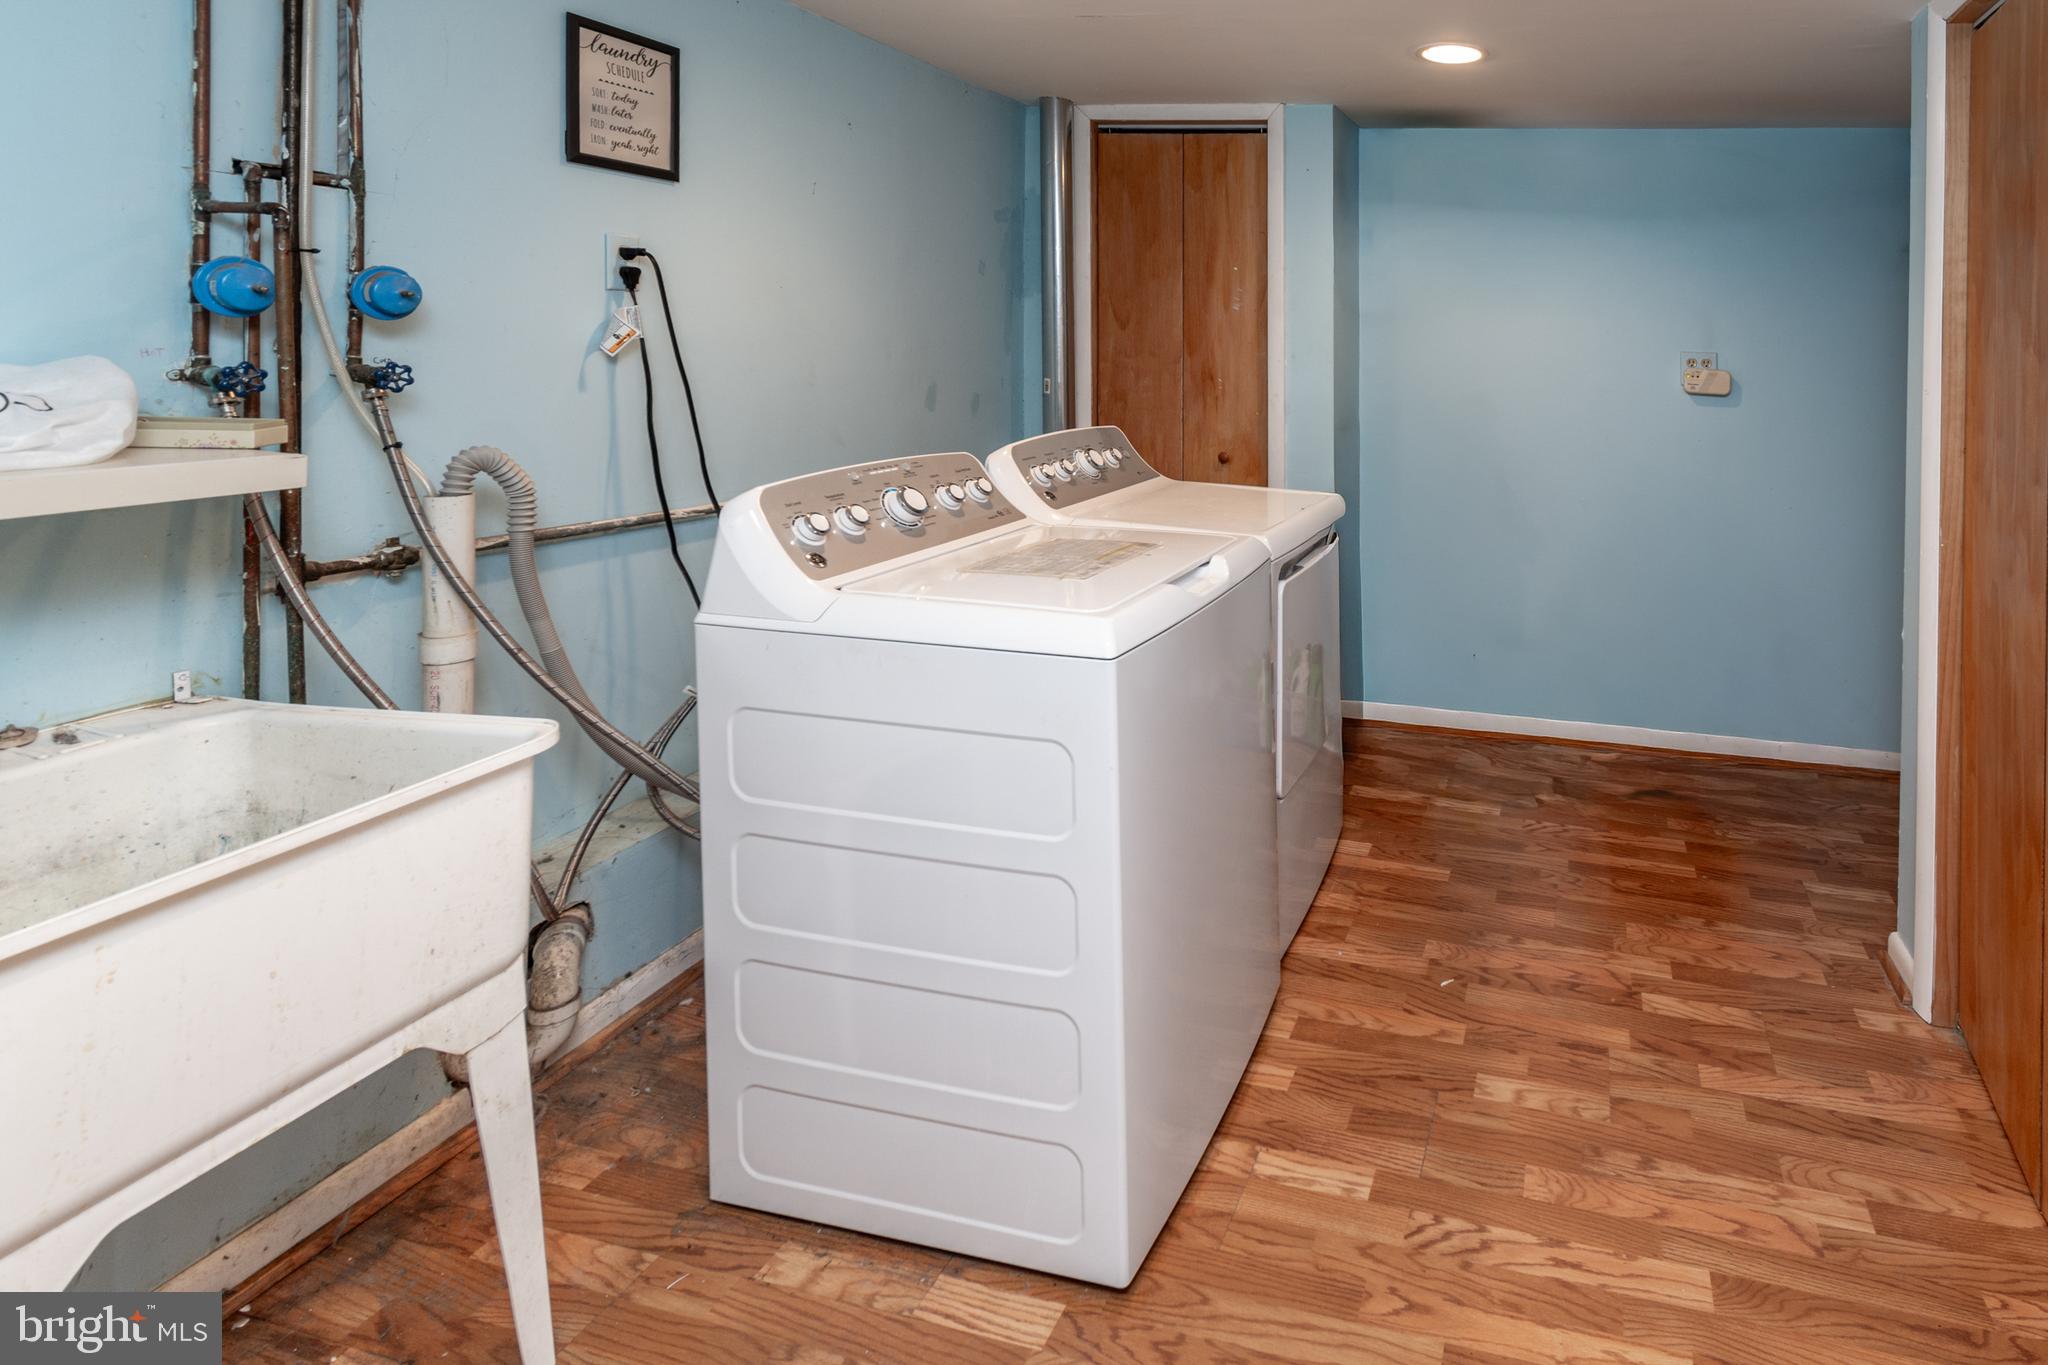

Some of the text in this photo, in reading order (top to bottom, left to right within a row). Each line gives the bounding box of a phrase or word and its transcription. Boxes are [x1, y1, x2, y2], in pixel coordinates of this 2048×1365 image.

[580, 34, 672, 78] laundry
[606, 61, 645, 84] SCHEDULE
[611, 91, 639, 110] today
[611, 107, 633, 120] later
[609, 124, 657, 143] eventually
[637, 144, 660, 157] right
